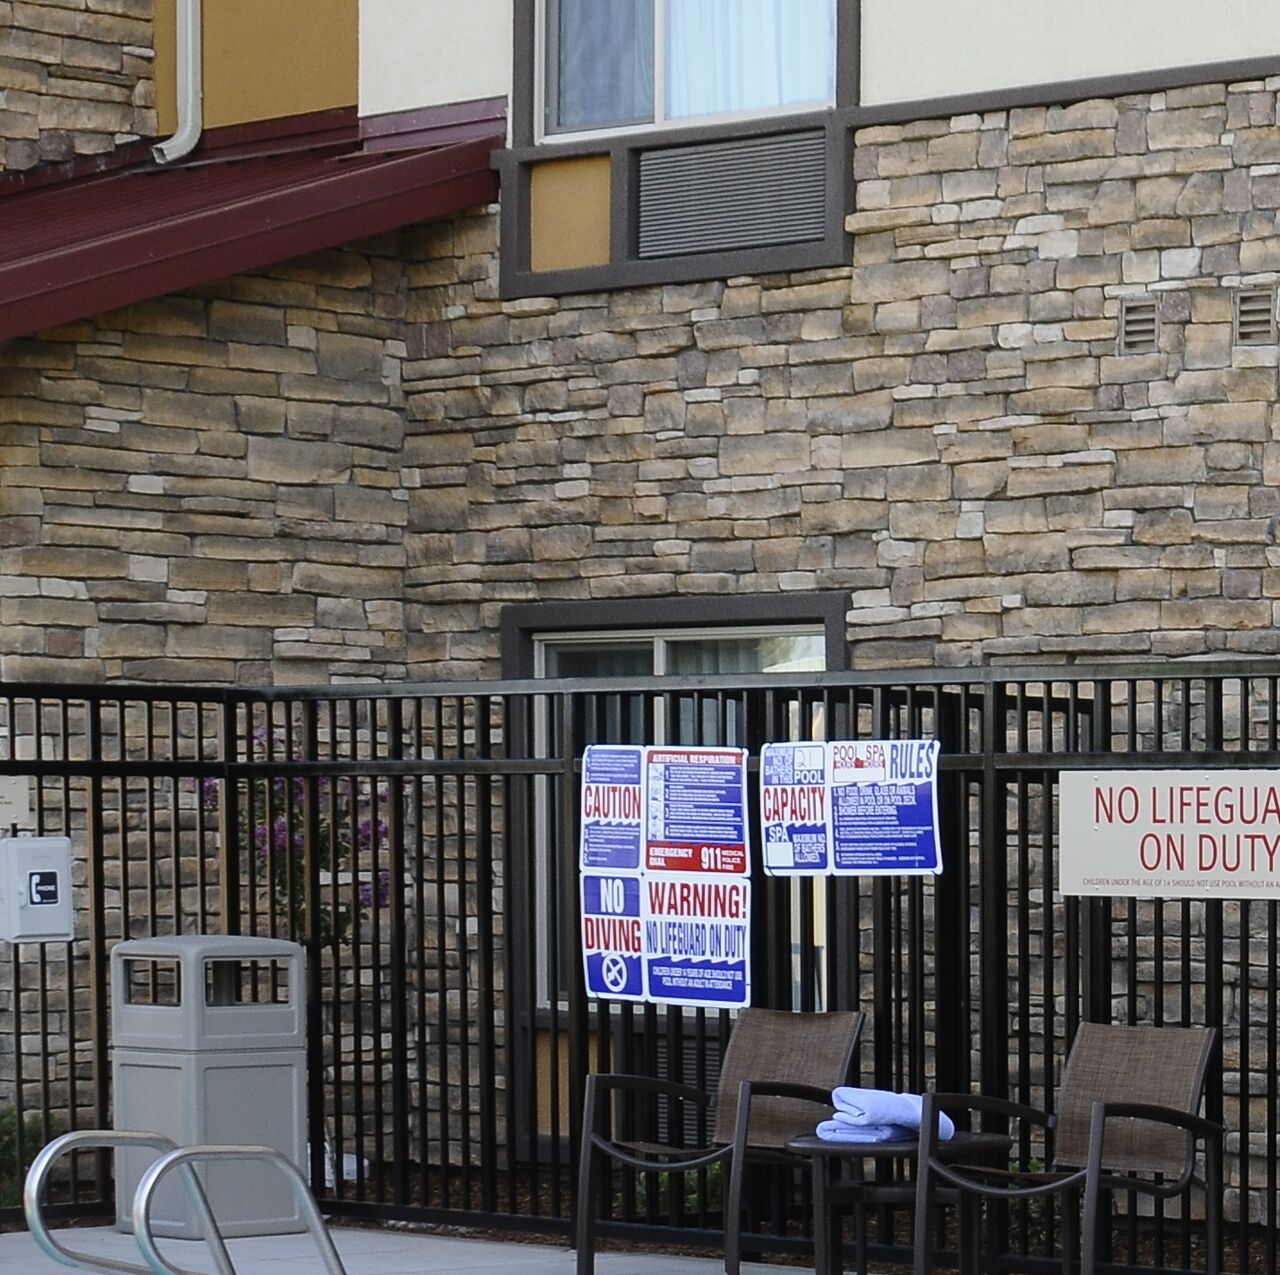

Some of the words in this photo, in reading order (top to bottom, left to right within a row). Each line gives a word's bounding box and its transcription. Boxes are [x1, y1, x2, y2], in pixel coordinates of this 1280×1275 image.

[833, 744, 858, 761] POOL
[866, 744, 885, 760] SPA
[890, 742, 935, 779] RULES
[794, 770, 825, 784] POOL
[584, 785, 641, 819] CAUTION
[763, 786, 825, 821] CAPACITY
[1095, 786, 1139, 824] NO
[768, 826, 789, 842] SPA
[701, 846, 721, 870] 911
[1140, 833, 1185, 871] ON
[600, 878, 625, 914] NO
[648, 881, 747, 919] WARNING!
[1142, 879, 1153, 887] AGE
[1172, 879, 1195, 887] SHOULD
[1221, 880, 1237, 888] POOL
[1239, 880, 1264, 888] WITHOUT
[584, 917, 641, 953] DIVING
[646, 920, 658, 954] NO
[660, 921, 706, 956] LIFEGUARD
[709, 923, 722, 957] ON
[725, 924, 747, 959] DUTY
